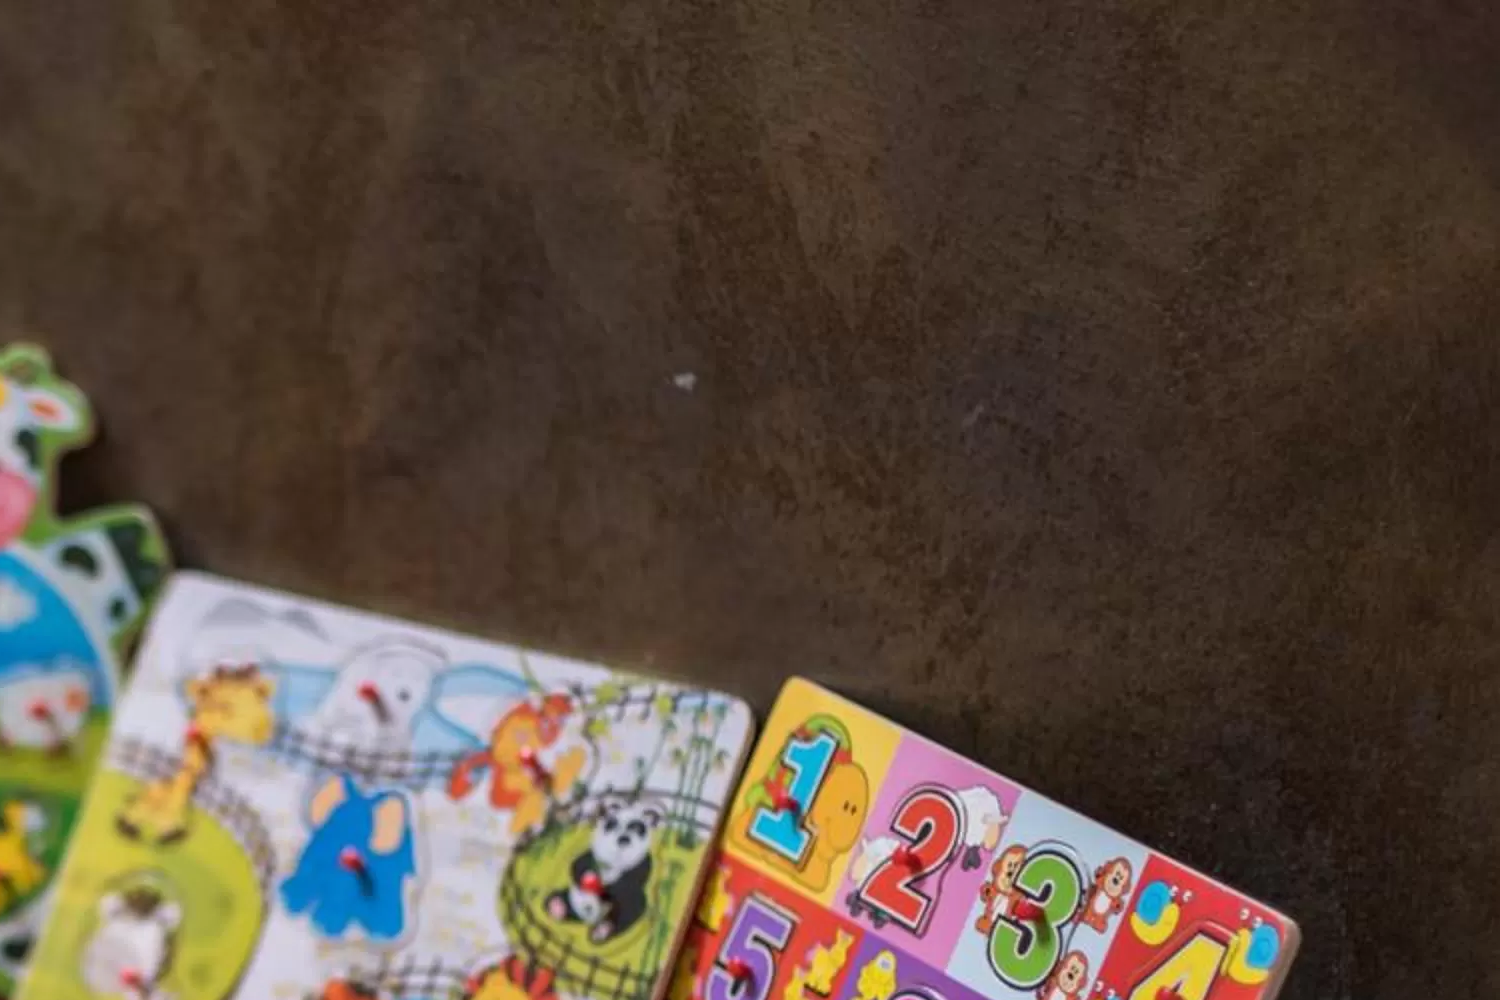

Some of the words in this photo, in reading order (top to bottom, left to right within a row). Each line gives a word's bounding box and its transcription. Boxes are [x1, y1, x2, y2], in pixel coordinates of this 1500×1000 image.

[750, 731, 839, 862] 1
[860, 787, 962, 932] 2
[987, 846, 1084, 990] 3
